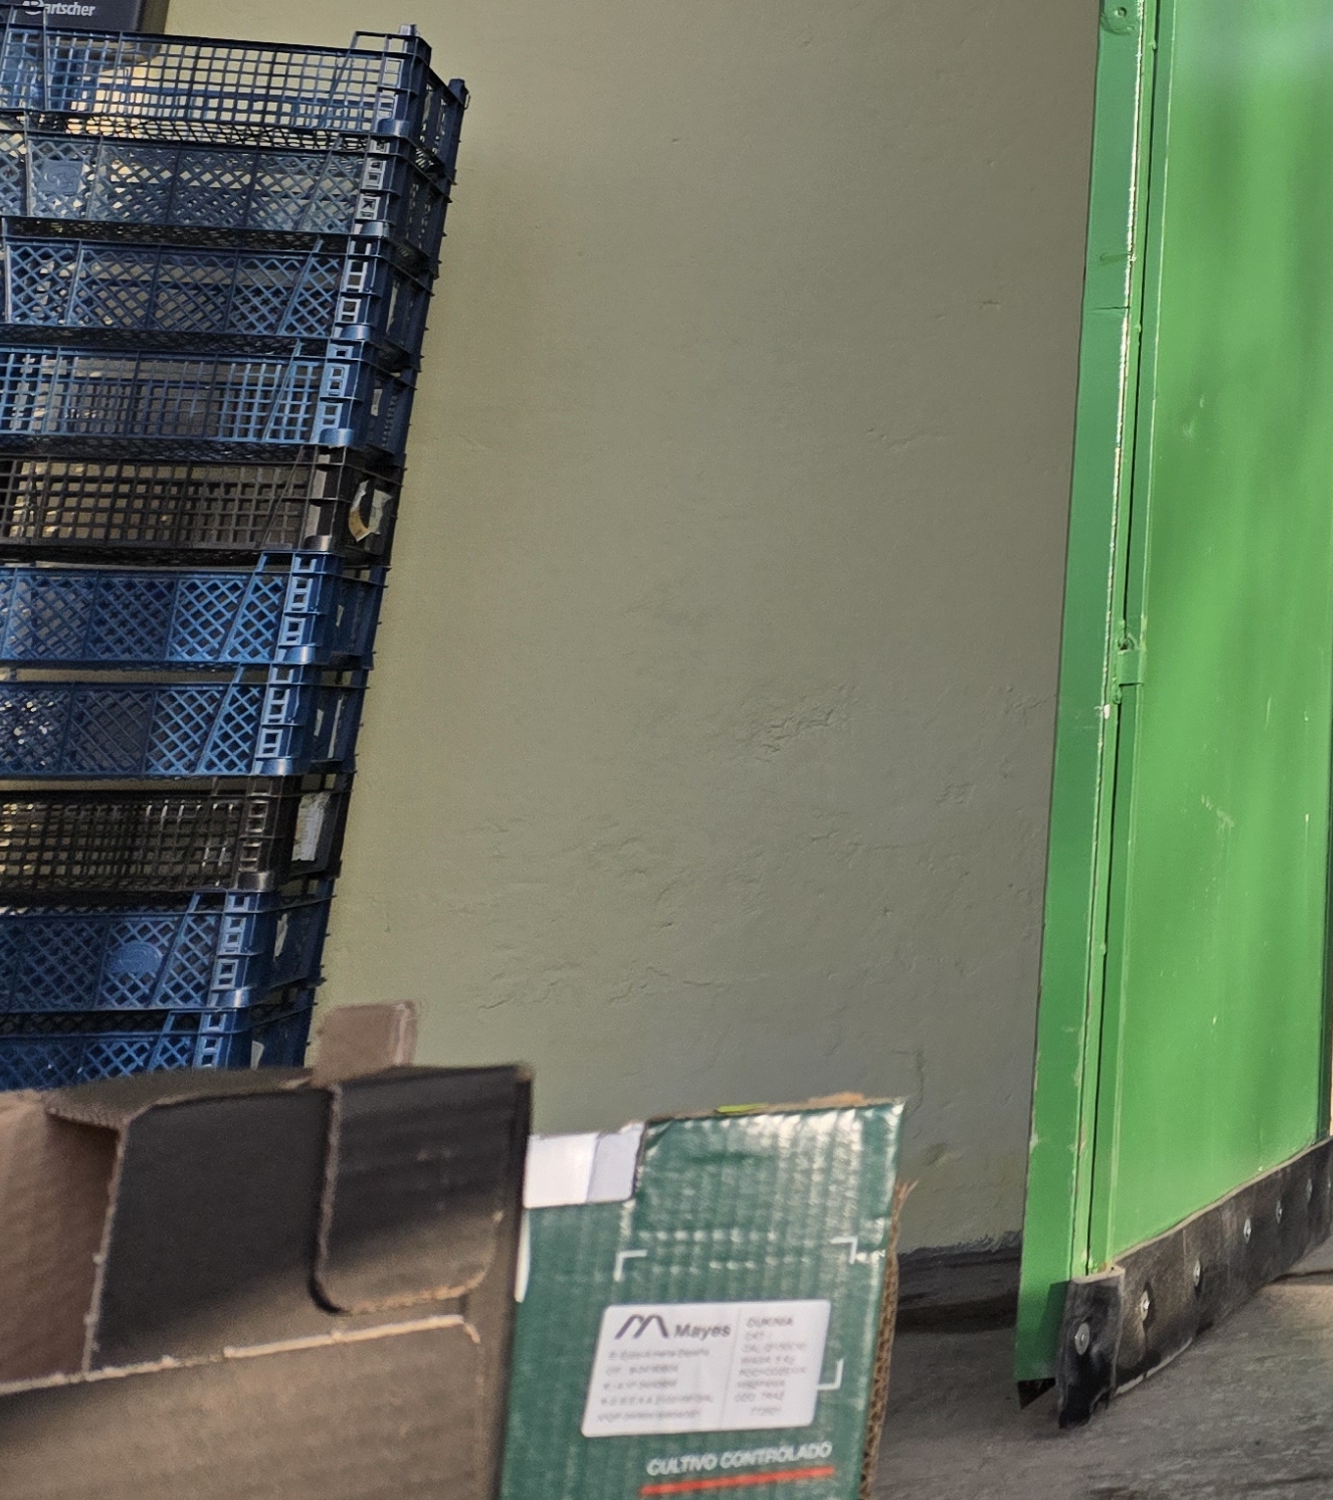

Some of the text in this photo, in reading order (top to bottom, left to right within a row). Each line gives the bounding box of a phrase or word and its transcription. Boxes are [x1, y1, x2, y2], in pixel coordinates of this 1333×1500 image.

[674, 1323, 732, 1341] Mayes
[646, 1441, 832, 1477] CULTIVO CONTROLADO
